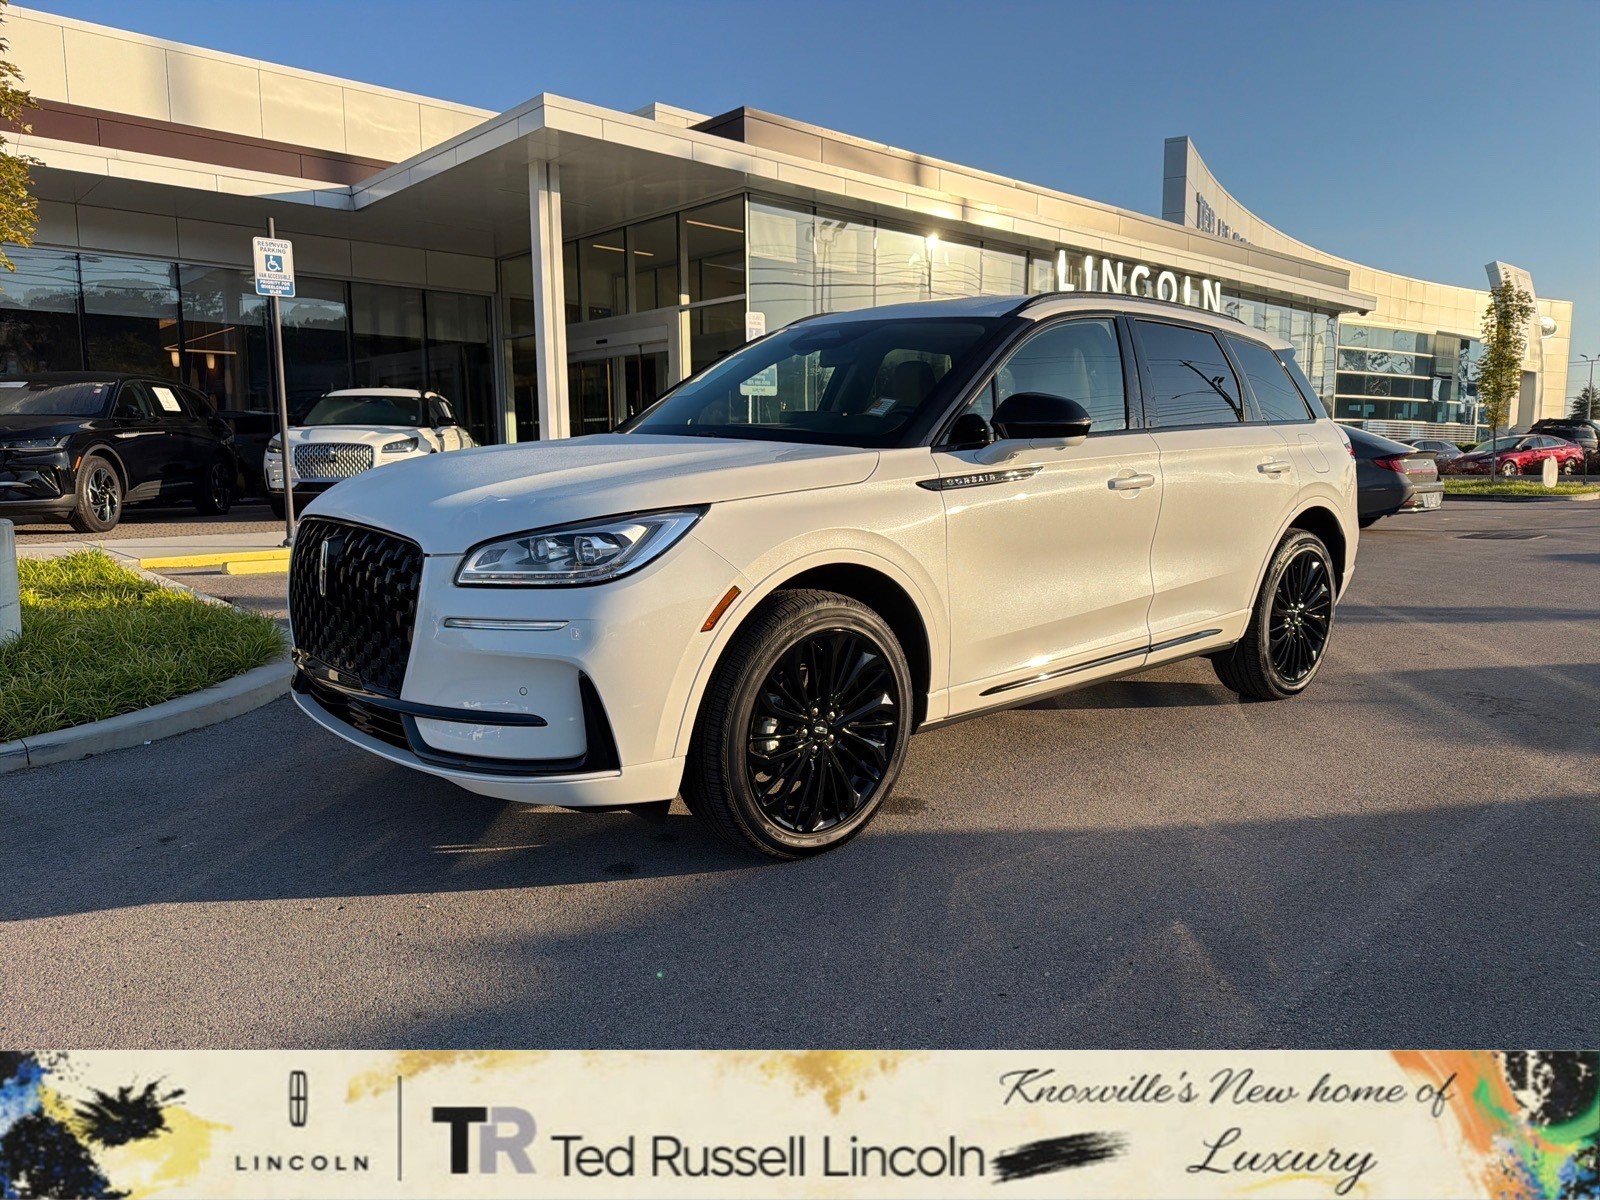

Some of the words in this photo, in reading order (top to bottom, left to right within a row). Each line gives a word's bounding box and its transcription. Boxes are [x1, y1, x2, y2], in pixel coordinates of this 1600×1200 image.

[257, 241, 288, 249] RESERVED
[260, 246, 286, 254] PARKING
[268, 273, 291, 281] ACCESSIBLE
[1057, 249, 1221, 313] LINCOLN
[946, 474, 996, 486] CORSAIR
